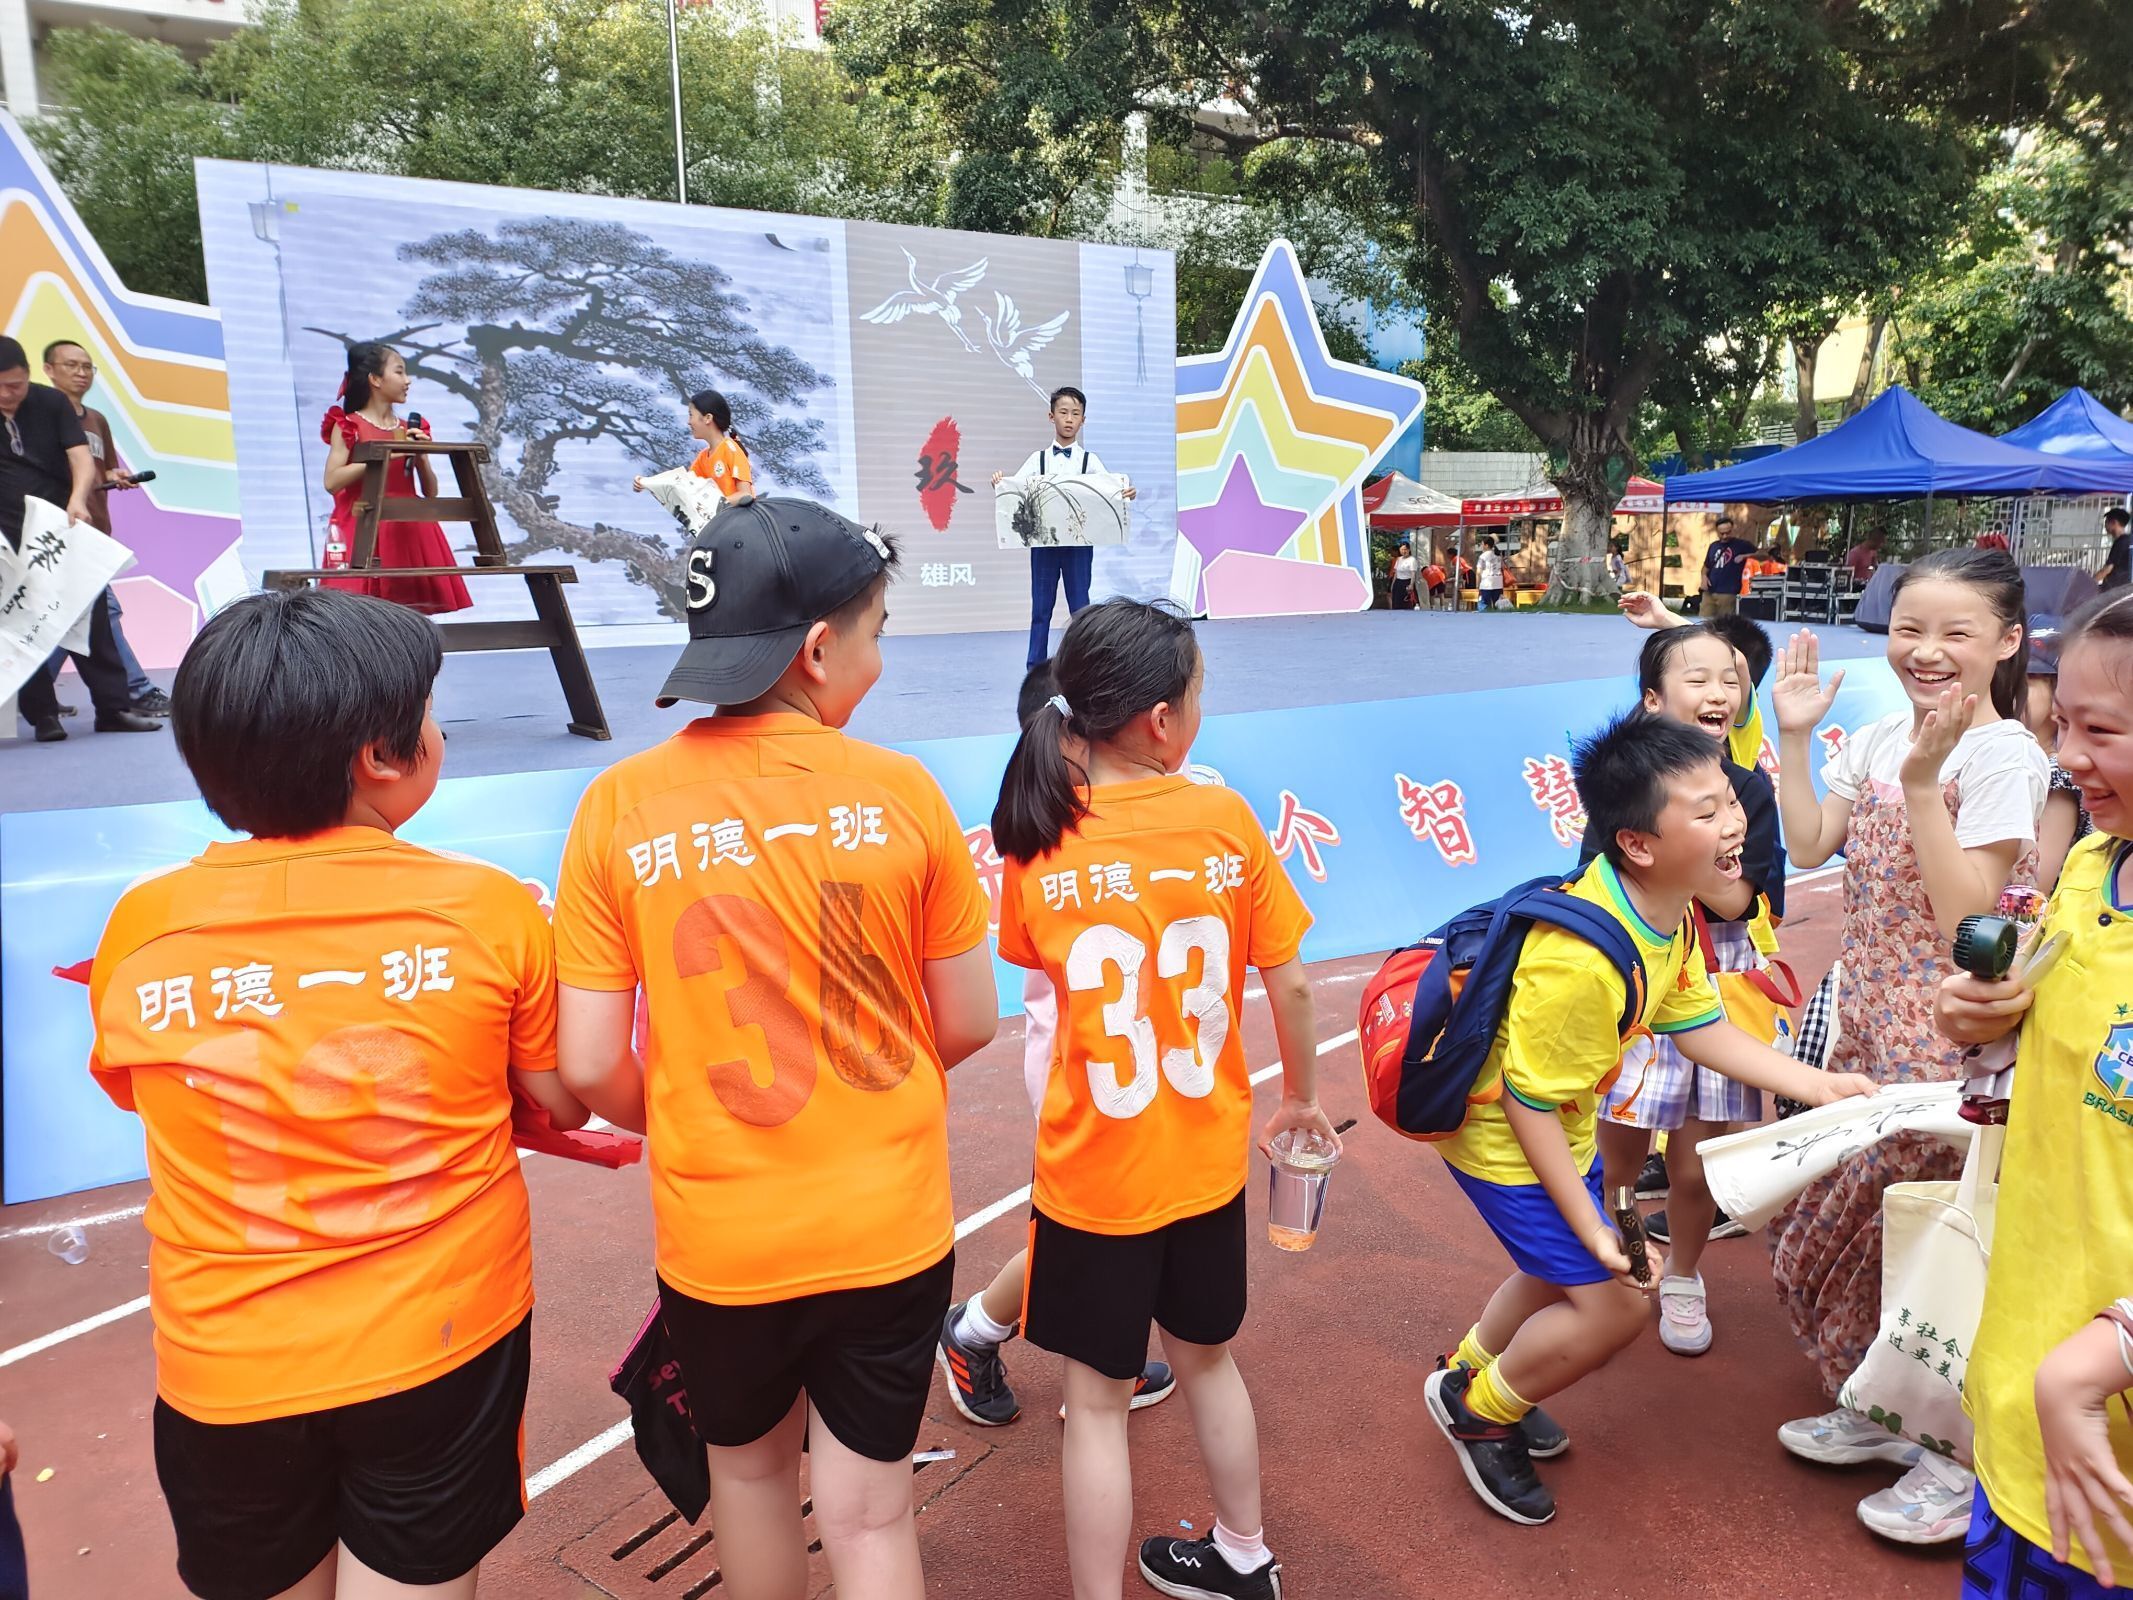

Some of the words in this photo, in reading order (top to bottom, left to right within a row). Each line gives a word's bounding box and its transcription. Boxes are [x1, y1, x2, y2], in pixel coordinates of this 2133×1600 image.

[920, 563, 976, 588] 雄风
[626, 801, 889, 887] 明德一班
[1039, 852, 1246, 911] 明德一班
[135, 943, 455, 1032] 明德一班
[673, 880, 916, 1128] 36
[1066, 915, 1230, 1119] 33
[1898, 1307, 1968, 1362] 享社会
